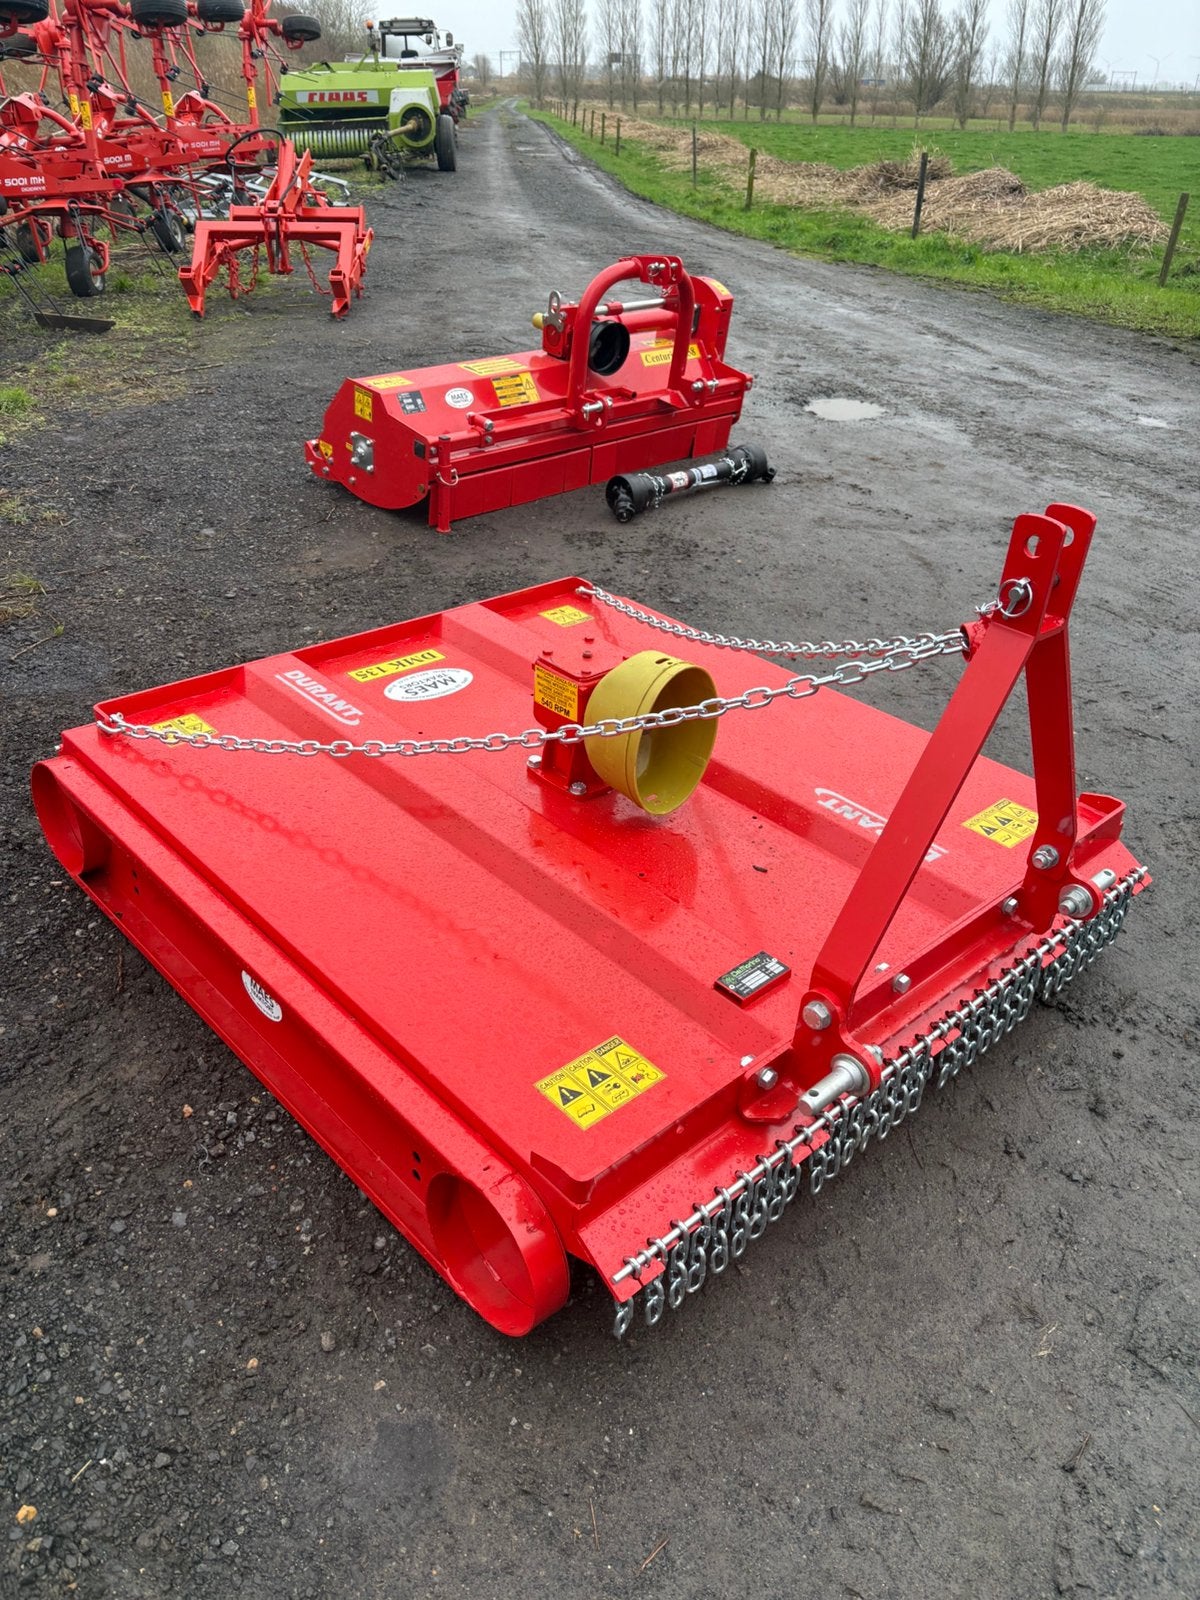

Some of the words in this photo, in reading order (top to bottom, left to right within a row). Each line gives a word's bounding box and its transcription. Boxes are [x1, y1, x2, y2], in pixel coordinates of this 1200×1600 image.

[308, 91, 368, 103] CLAAS
[103, 155, 123, 165] 5001
[4, 177, 28, 187] 5001
[389, 651, 437, 670] DMK
[355, 666, 387, 680] 135
[399, 673, 449, 689] TRAKTORS
[283, 669, 364, 717] DURANT
[404, 675, 457, 697] MAES
[541, 697, 553, 709] 540
[554, 703, 570, 717] RPM
[595, 1038, 621, 1056] DANGER
[568, 1055, 594, 1072] CAUTION
[539, 1072, 565, 1090] CAUTION
